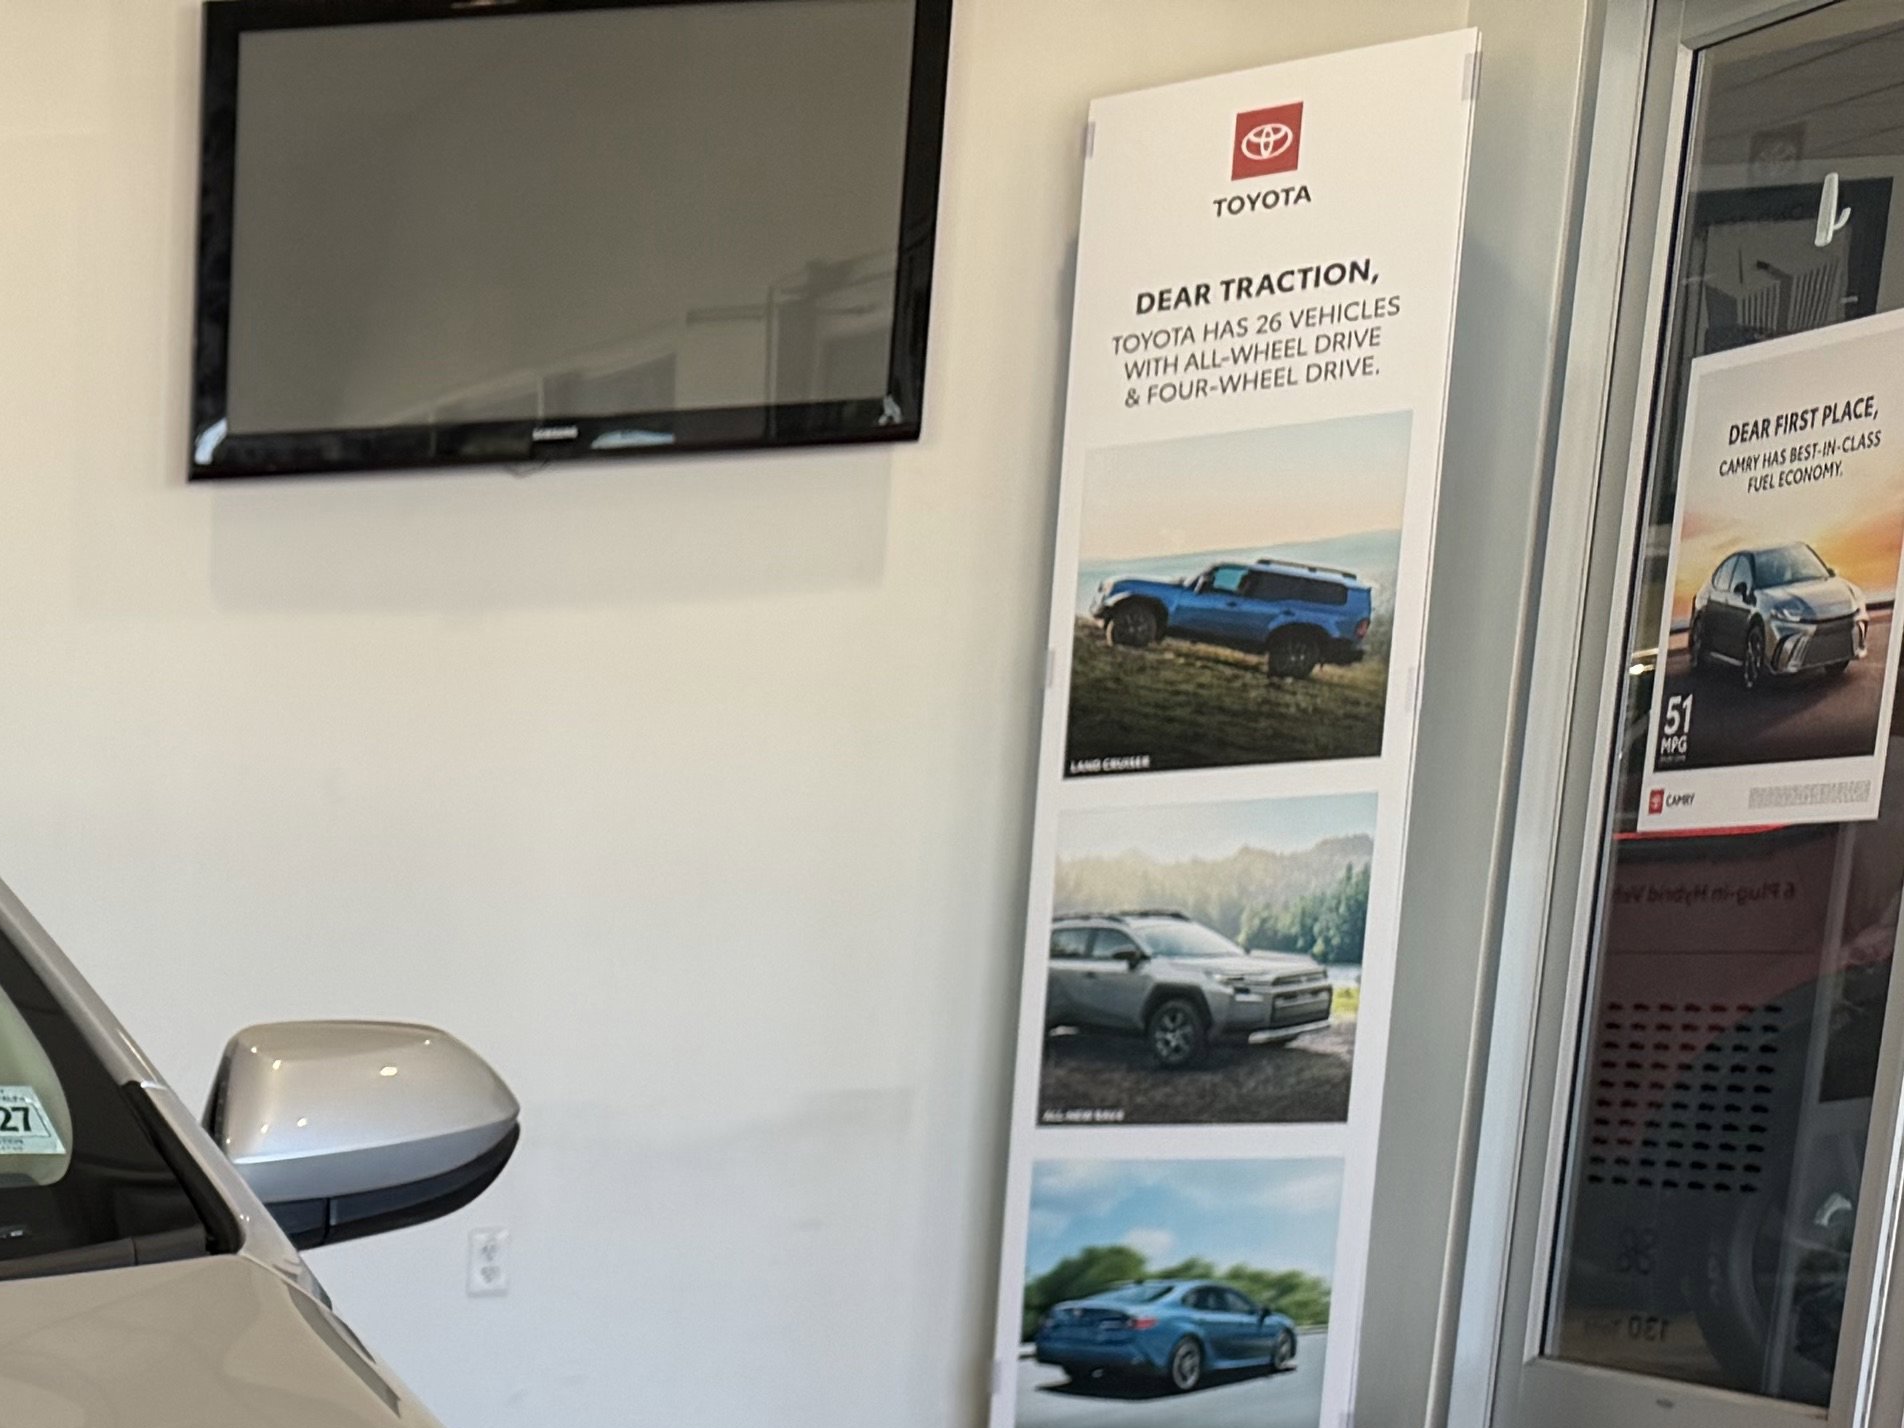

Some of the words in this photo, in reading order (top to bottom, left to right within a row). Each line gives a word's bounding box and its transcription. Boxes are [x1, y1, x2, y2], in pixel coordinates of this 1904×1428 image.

[1213, 185, 1312, 218] TOYOTA
[1136, 283, 1210, 315] DEAR
[1220, 258, 1379, 302] TRACTION,
[1112, 325, 1195, 356] TOYOTA
[1203, 317, 1249, 342] HAS
[1256, 312, 1282, 335] 26
[1289, 295, 1401, 328] VEHICLES
[1124, 355, 1179, 380] WITH
[1184, 337, 1308, 373] ALL-WHEEL
[1314, 326, 1382, 354] DRIVE
[1125, 388, 1140, 408] &
[1147, 366, 1298, 405] FOUR-WHEEL
[1306, 355, 1380, 383] DRIVE.
[1728, 418, 1771, 446] DEAR
[1774, 406, 1819, 436] FIRST
[1821, 395, 1879, 426] PLACE,
[1719, 454, 1760, 477] CAMRY
[1762, 448, 1786, 468] HAS
[1789, 430, 1882, 463] BEST-IN-CLASS
[1747, 476, 1775, 494] FUEL
[1778, 460, 1843, 488] ECONOMY.
[1664, 694, 1694, 735] 51
[1660, 735, 1688, 755] MPG
[1665, 792, 1695, 807] CAMRY
